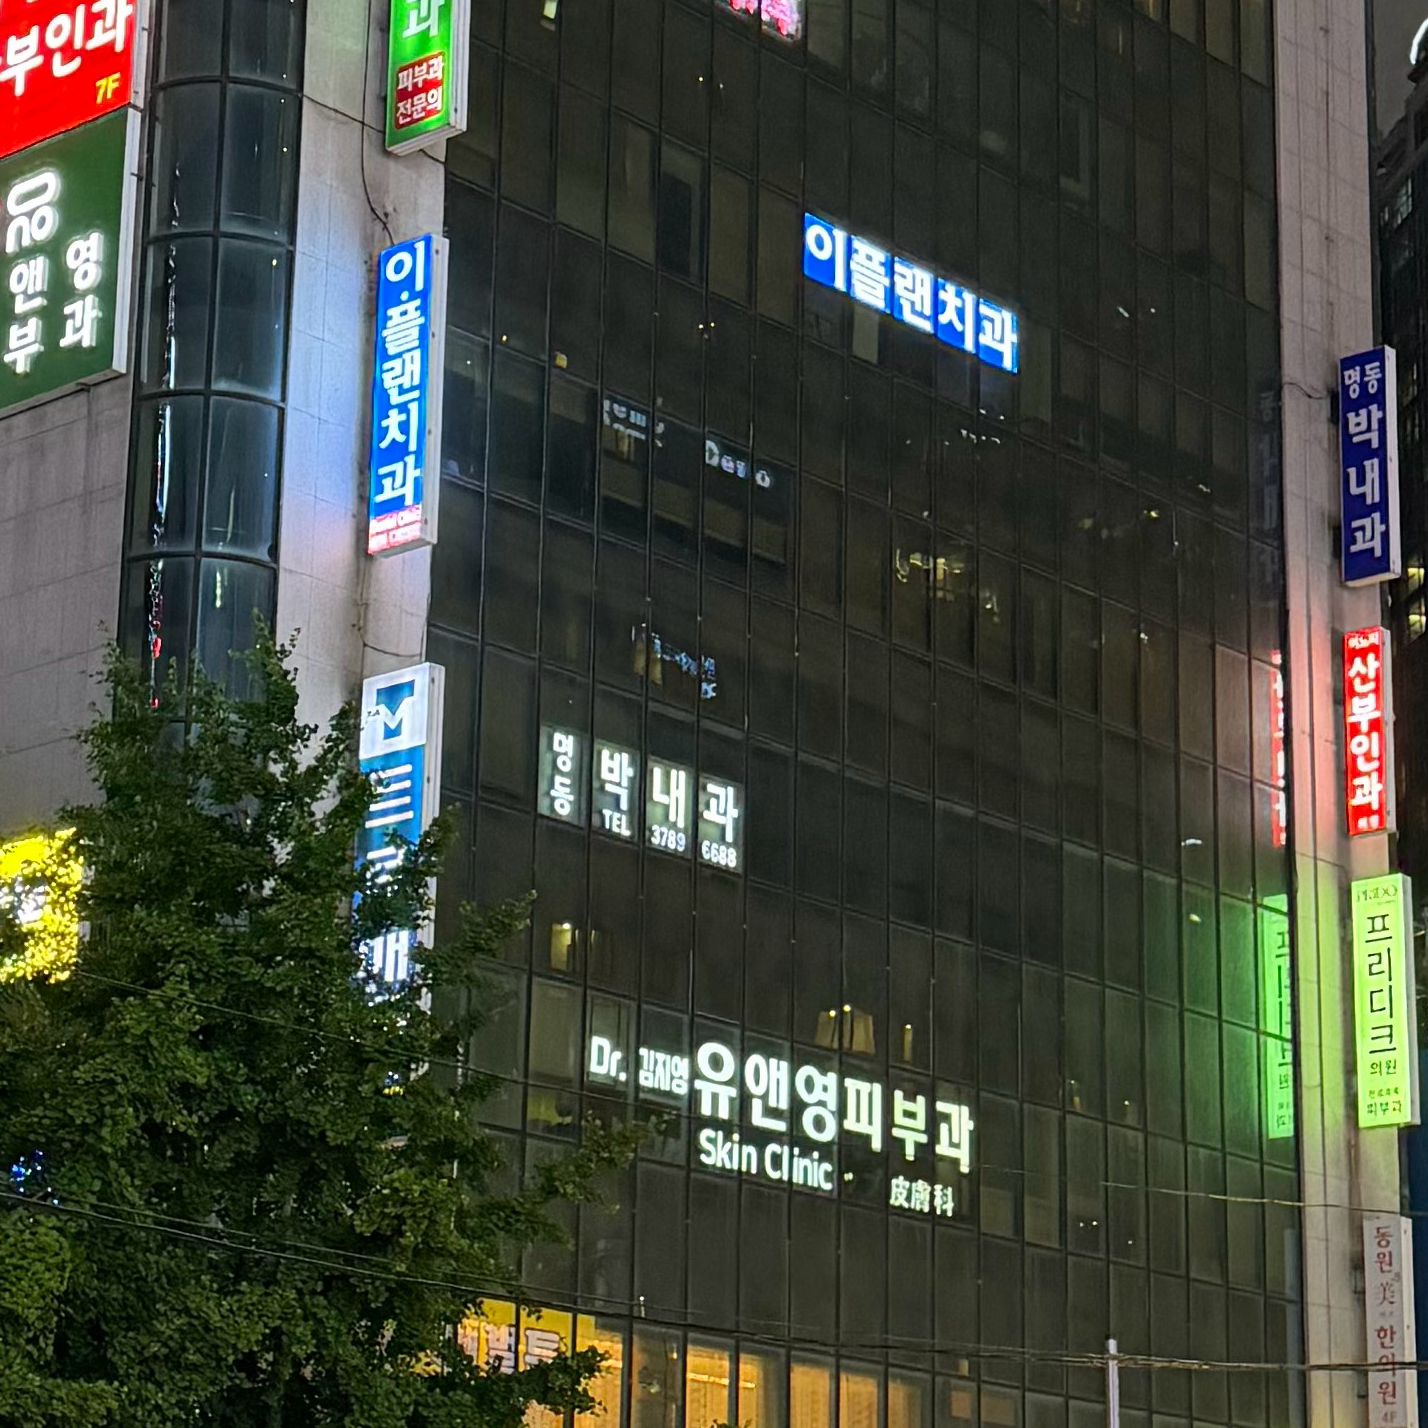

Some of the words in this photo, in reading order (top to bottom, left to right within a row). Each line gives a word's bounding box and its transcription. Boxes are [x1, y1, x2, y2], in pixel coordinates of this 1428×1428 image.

[95, 77, 119, 105] 7F
[806, 224, 1017, 370] 이플랜치과
[1343, 361, 1381, 401] 명동
[1345, 404, 1386, 559] 박내과
[550, 731, 575, 818] 명동
[1347, 652, 1384, 812] 산부인과
[601, 748, 740, 844] 박내과
[603, 808, 632, 837] TEL
[651, 824, 686, 852] 3789
[701, 839, 738, 869] 6688
[1365, 913, 1397, 1055] 프리디크
[590, 1035, 628, 1082] Dr.
[694, 1041, 975, 1175] 유앤영피부과
[698, 1127, 758, 1175] Skin
[763, 1142, 835, 1191] Clinic
